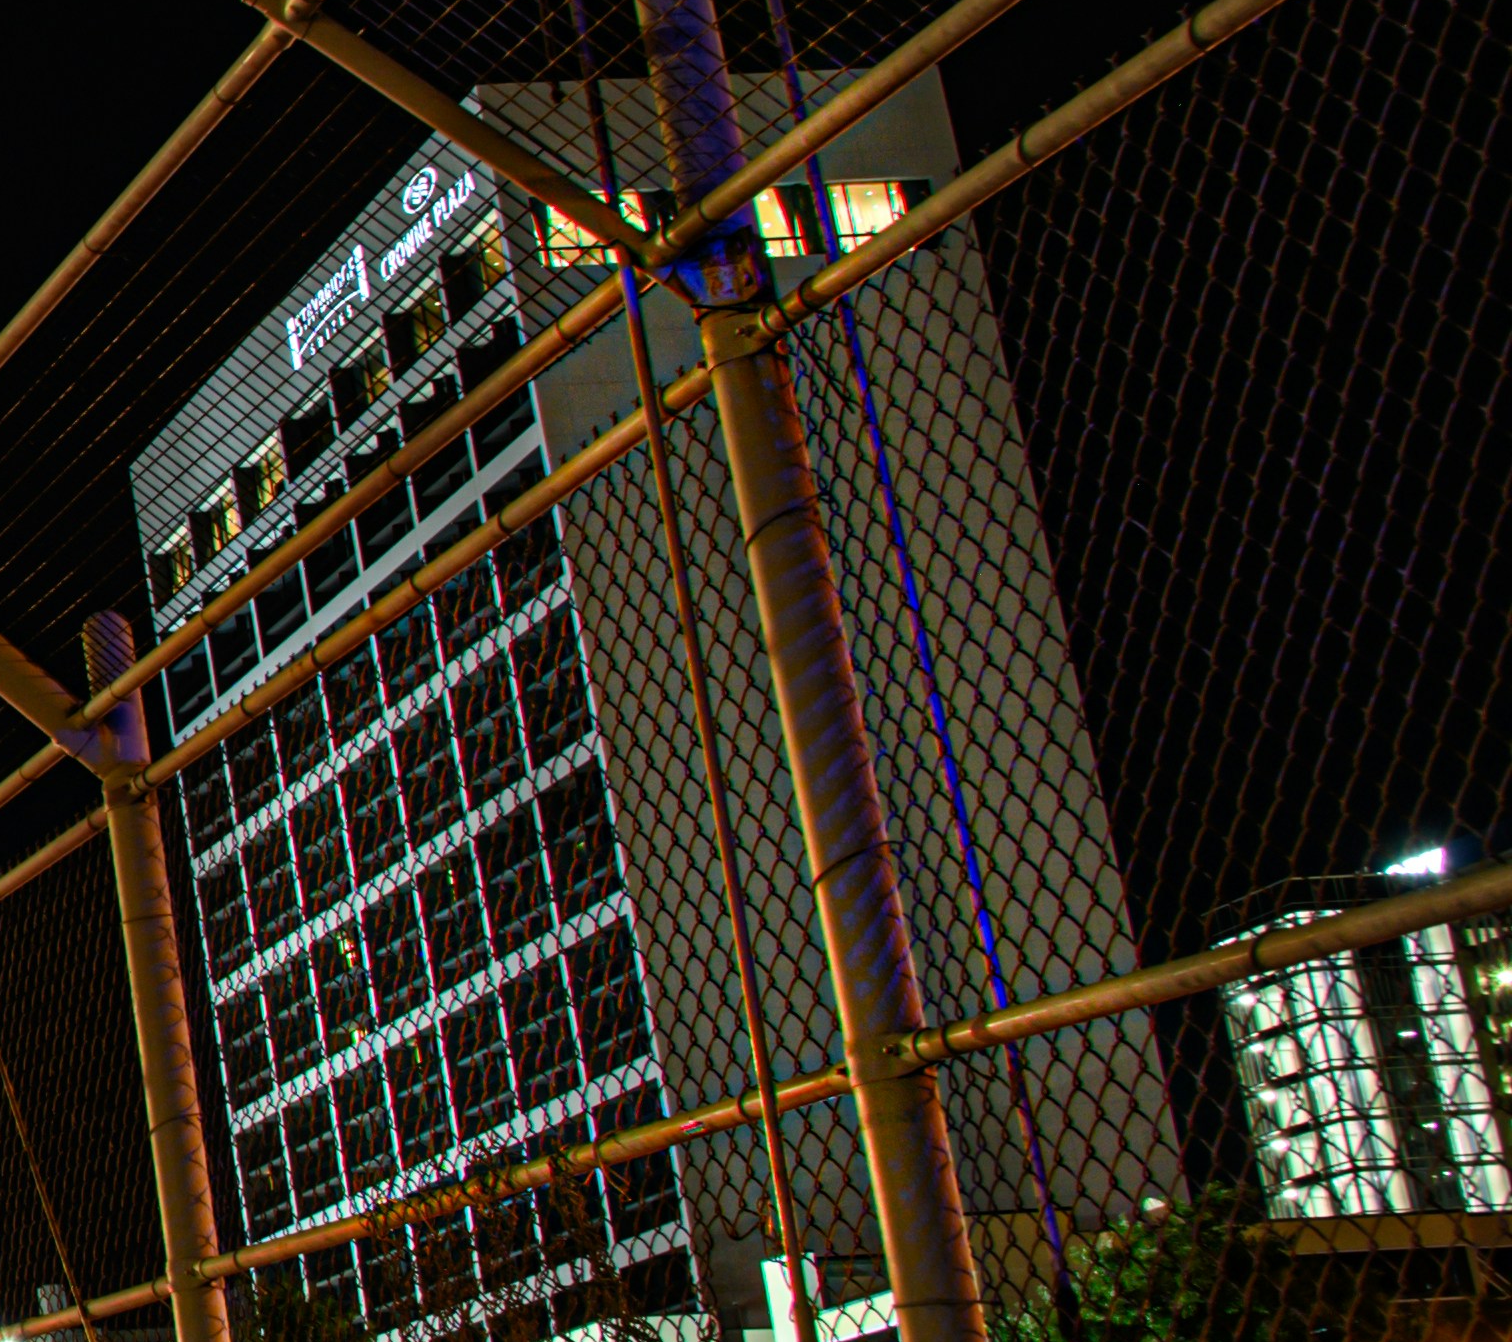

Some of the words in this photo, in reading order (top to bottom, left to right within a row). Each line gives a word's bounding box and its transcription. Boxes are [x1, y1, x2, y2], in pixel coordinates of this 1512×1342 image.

[380, 212, 434, 283] CROWNE
[432, 171, 476, 228] PLAZA
[309, 304, 354, 356] SUITES
